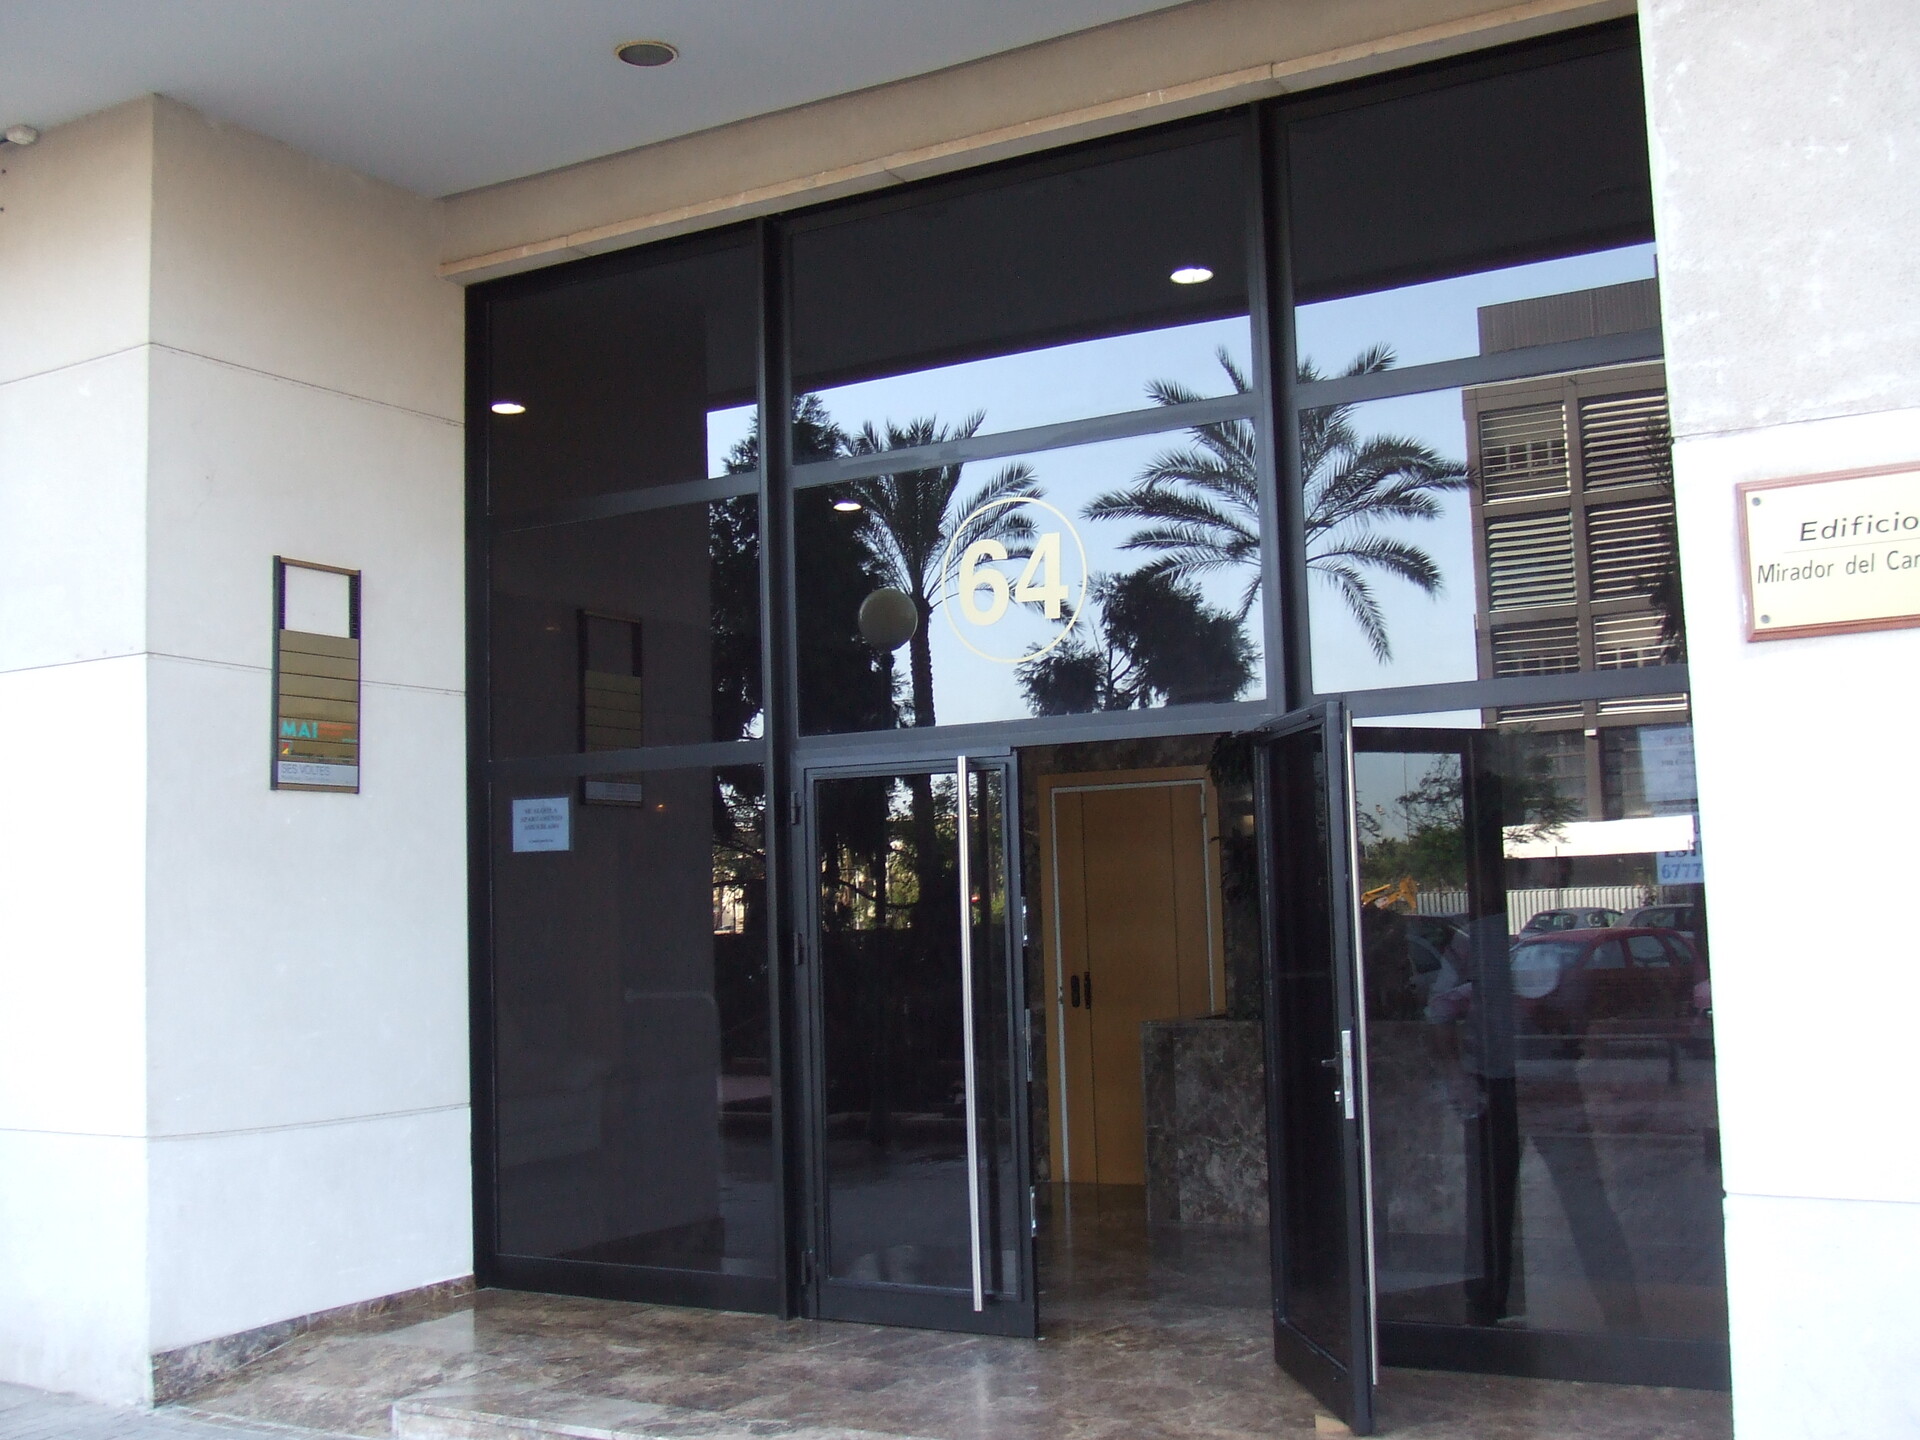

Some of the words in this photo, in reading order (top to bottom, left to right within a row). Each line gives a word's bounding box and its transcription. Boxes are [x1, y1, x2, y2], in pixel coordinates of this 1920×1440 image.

[1799, 511, 1919, 542] Edificio
[959, 532, 1069, 626] 64
[1757, 560, 1834, 584] Mirador
[1845, 553, 1875, 575] del
[280, 720, 319, 739] MAI
